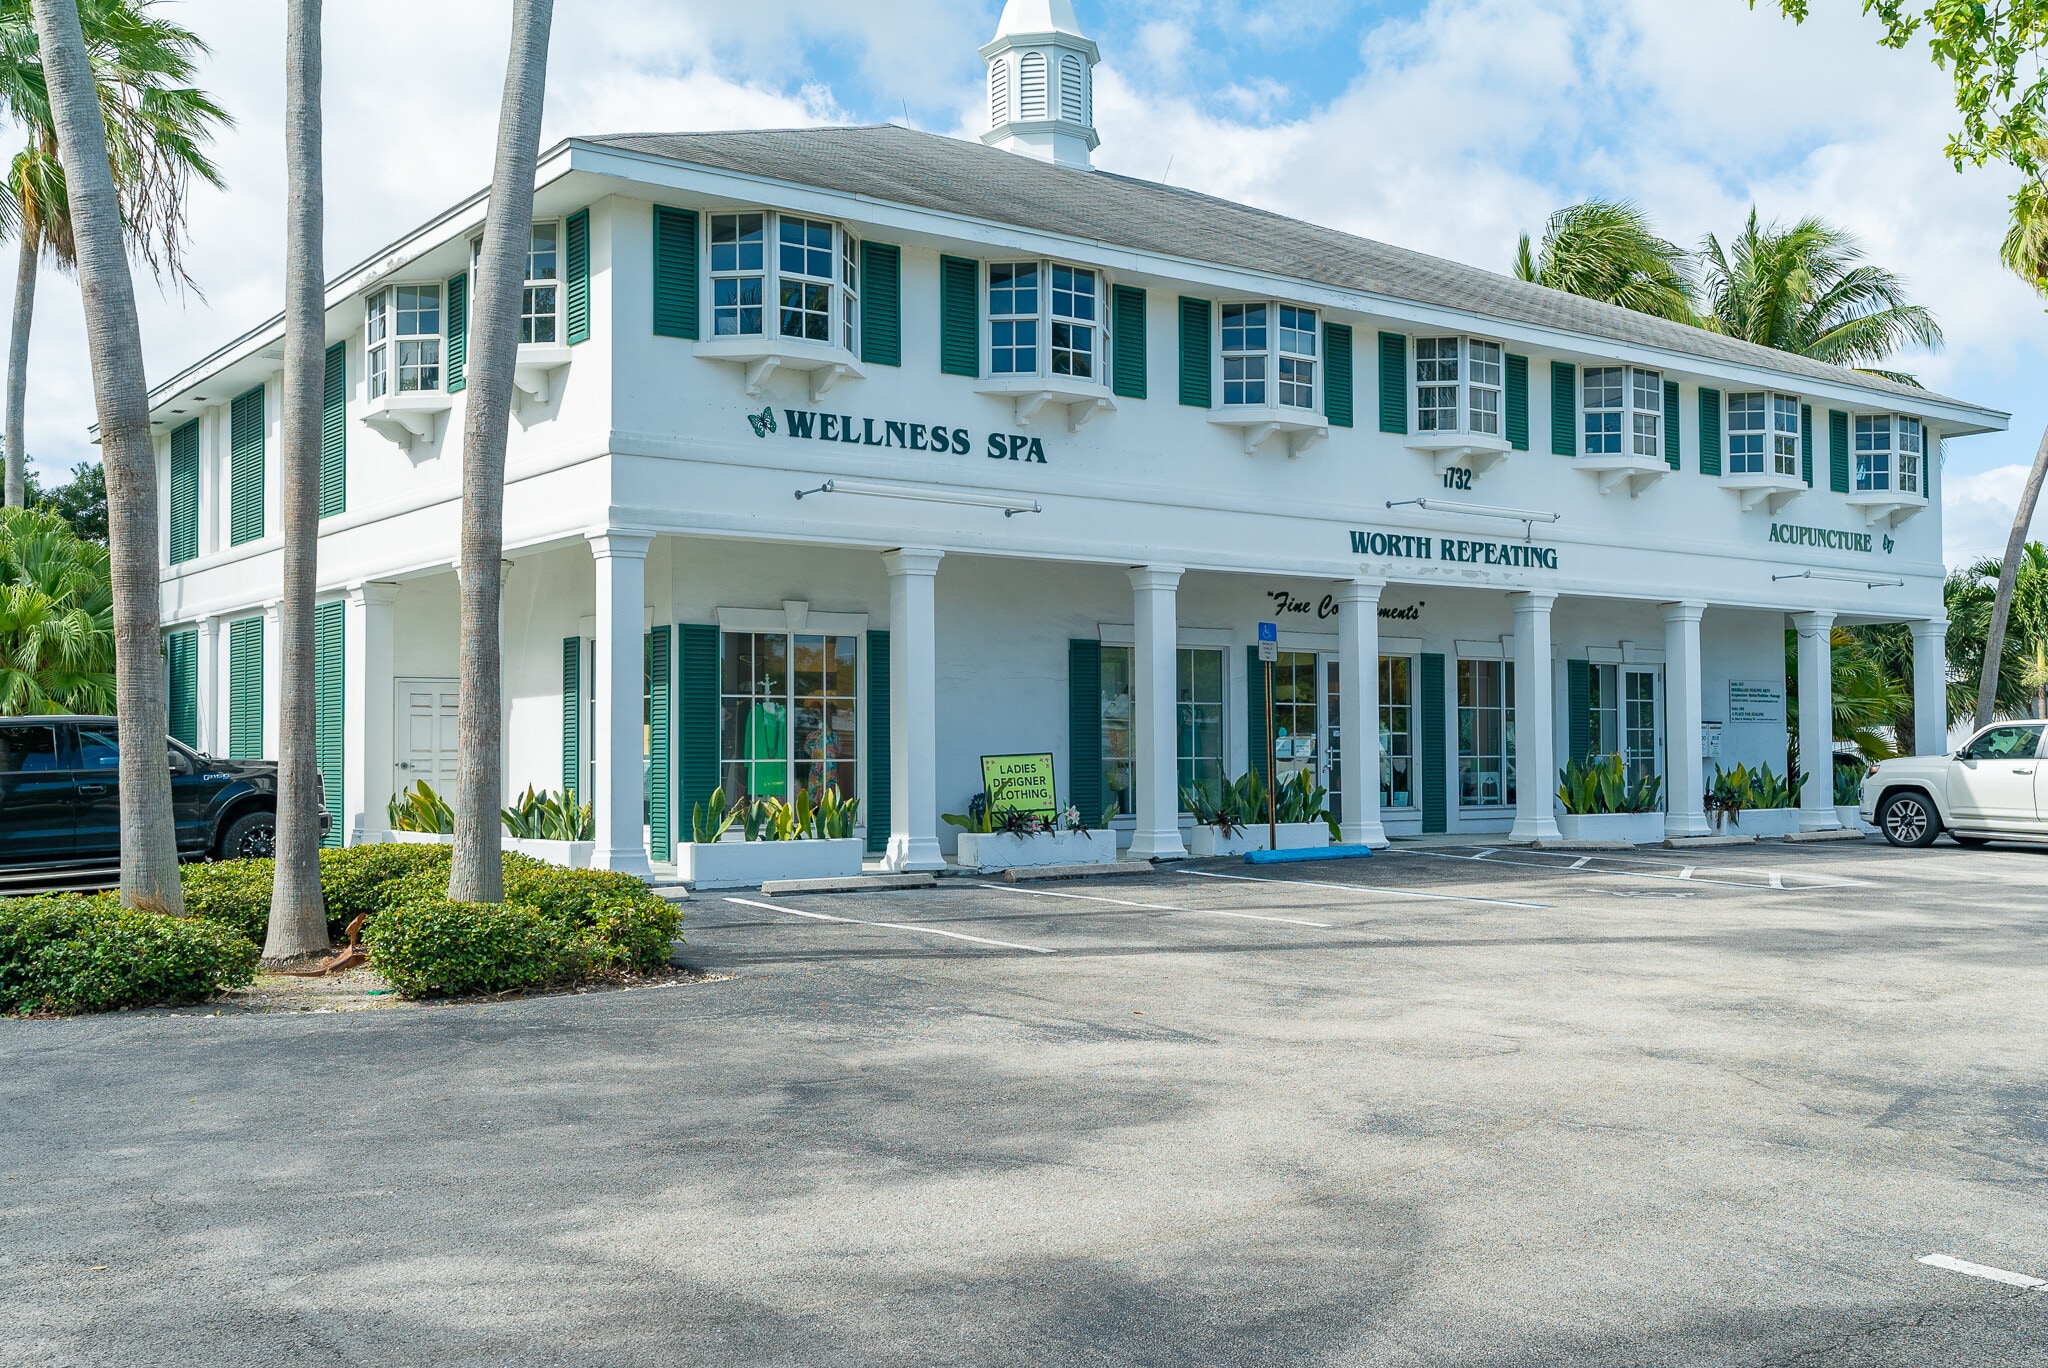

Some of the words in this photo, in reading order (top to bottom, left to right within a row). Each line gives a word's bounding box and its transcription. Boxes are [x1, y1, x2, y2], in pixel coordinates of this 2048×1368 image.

[784, 409, 971, 455] WELLNESS
[987, 432, 1048, 464] SPA
[1443, 467, 1472, 490] 1732
[1349, 531, 1432, 559] WORTH
[1440, 538, 1558, 570] REPEATING
[1769, 523, 1872, 552] ACUPUNCTURE
[1000, 764, 1036, 774] LADIES
